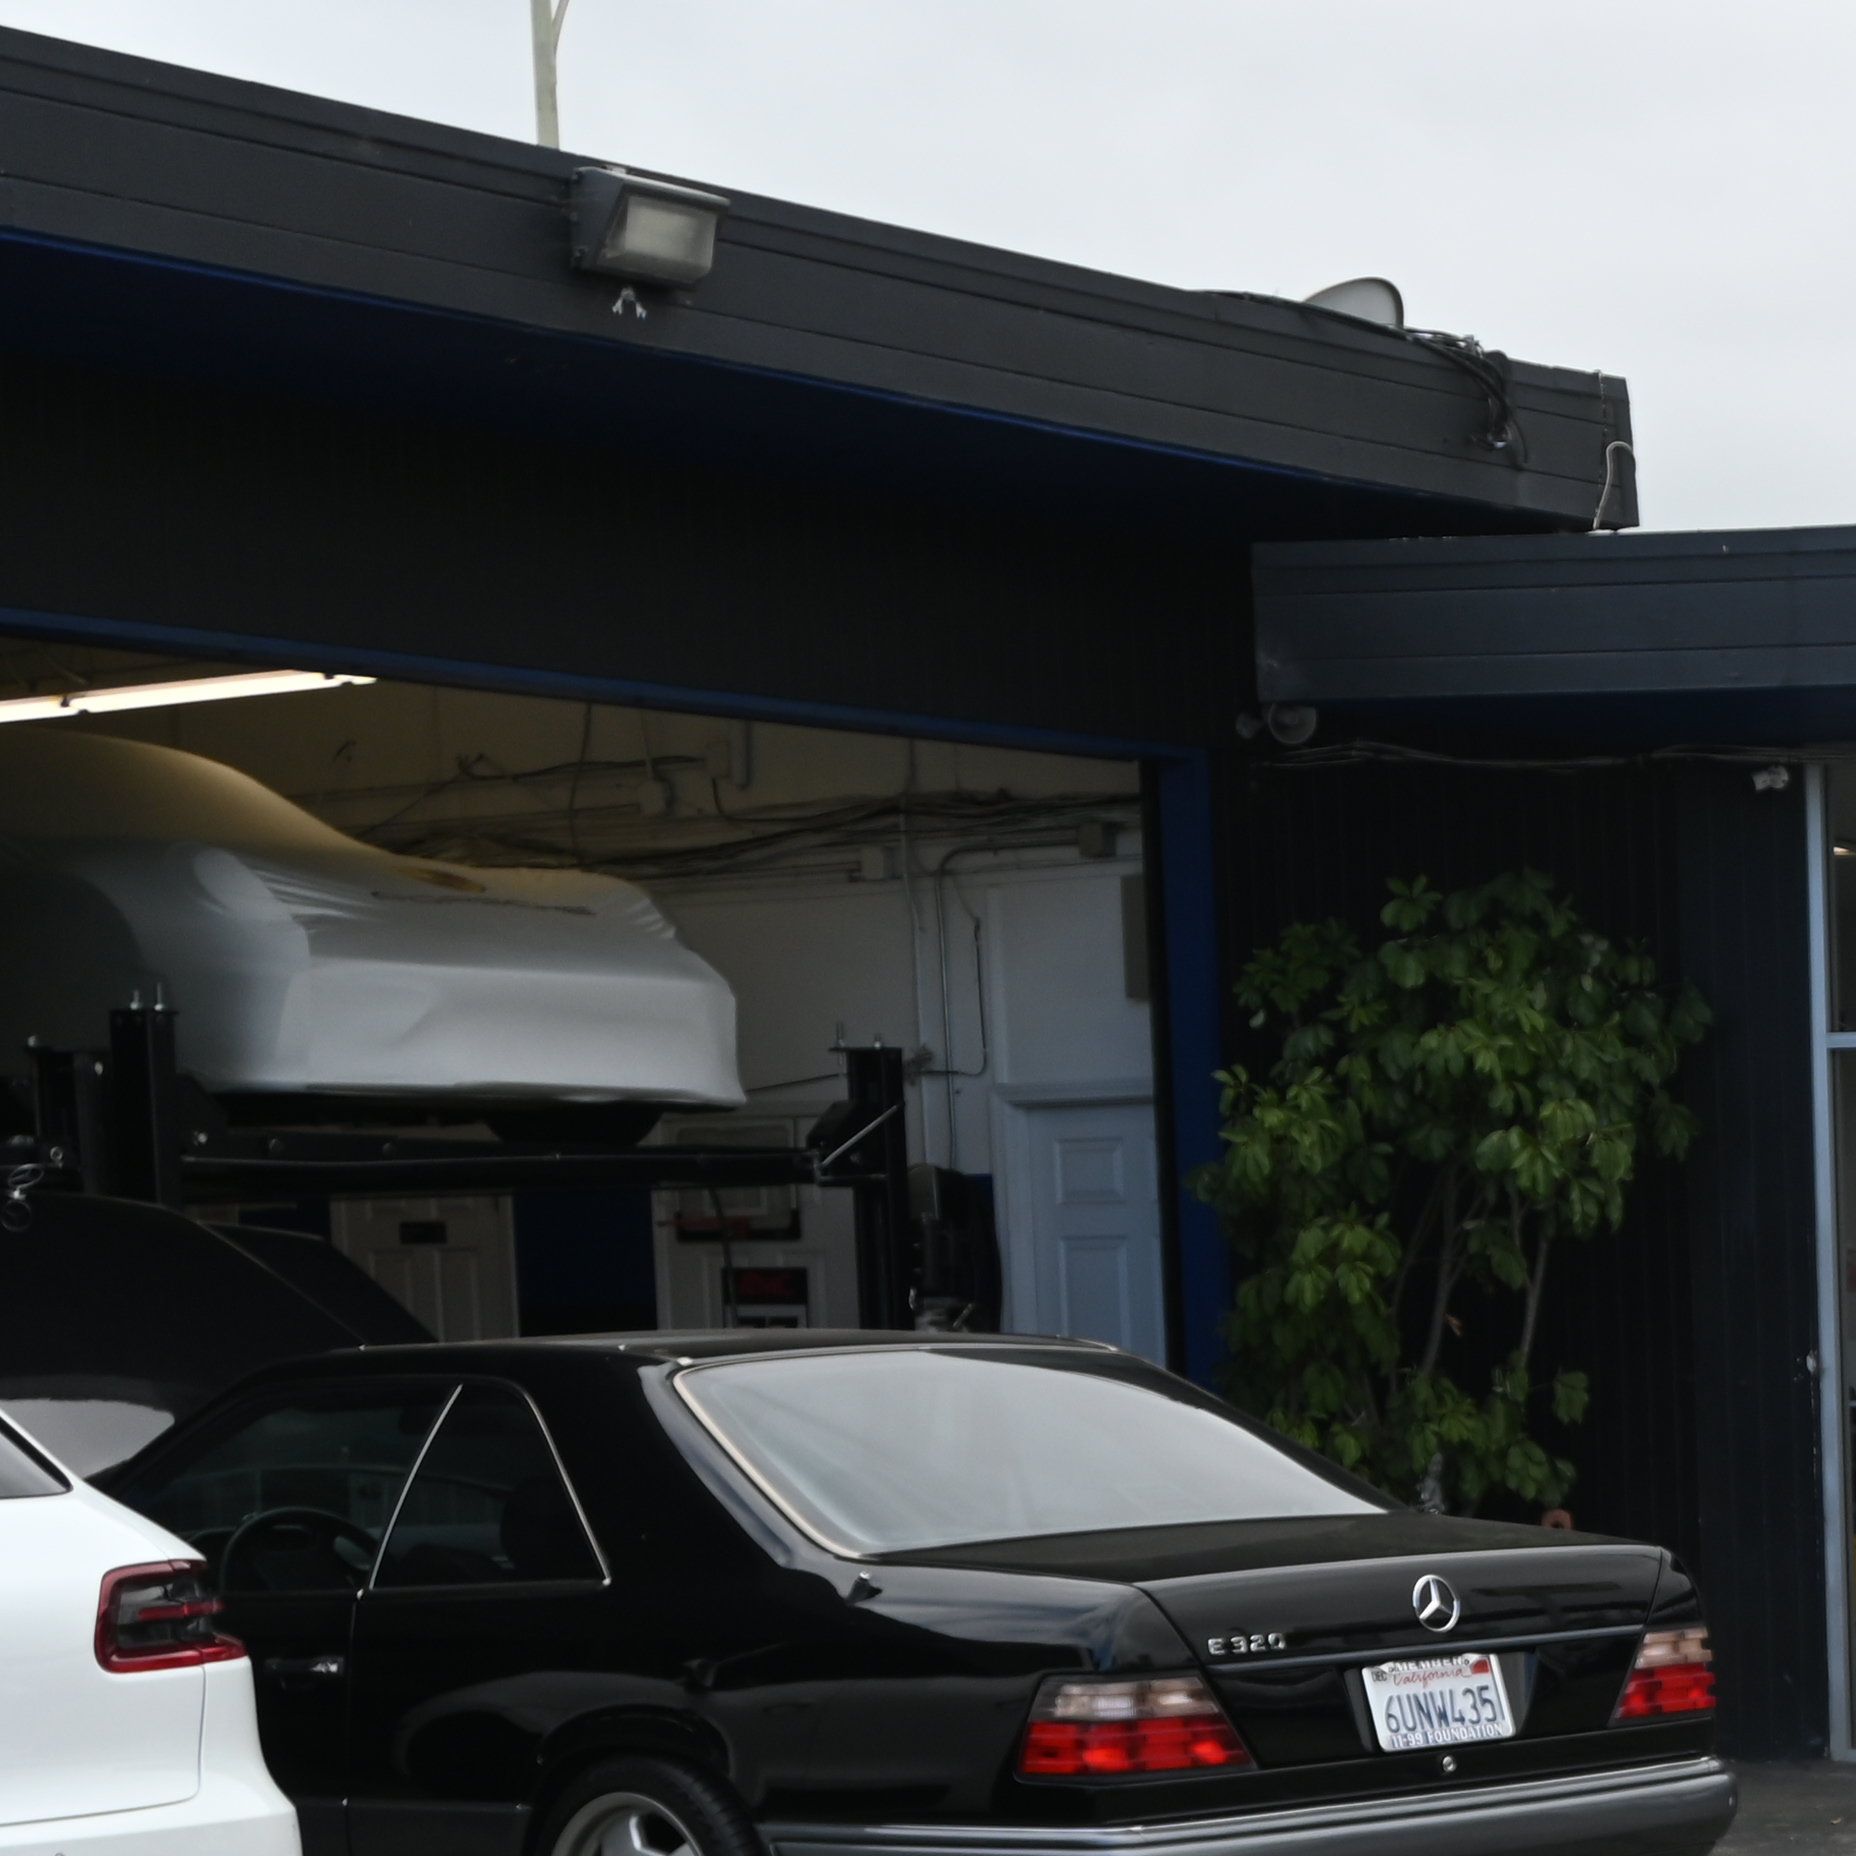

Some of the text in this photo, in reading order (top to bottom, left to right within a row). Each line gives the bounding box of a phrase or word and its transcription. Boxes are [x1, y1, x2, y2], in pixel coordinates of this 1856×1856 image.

[1393, 1667, 1471, 1689] California
[1385, 1685, 1497, 1734] 6UNW435
[1427, 1723, 1504, 1745] FOUNDATION
